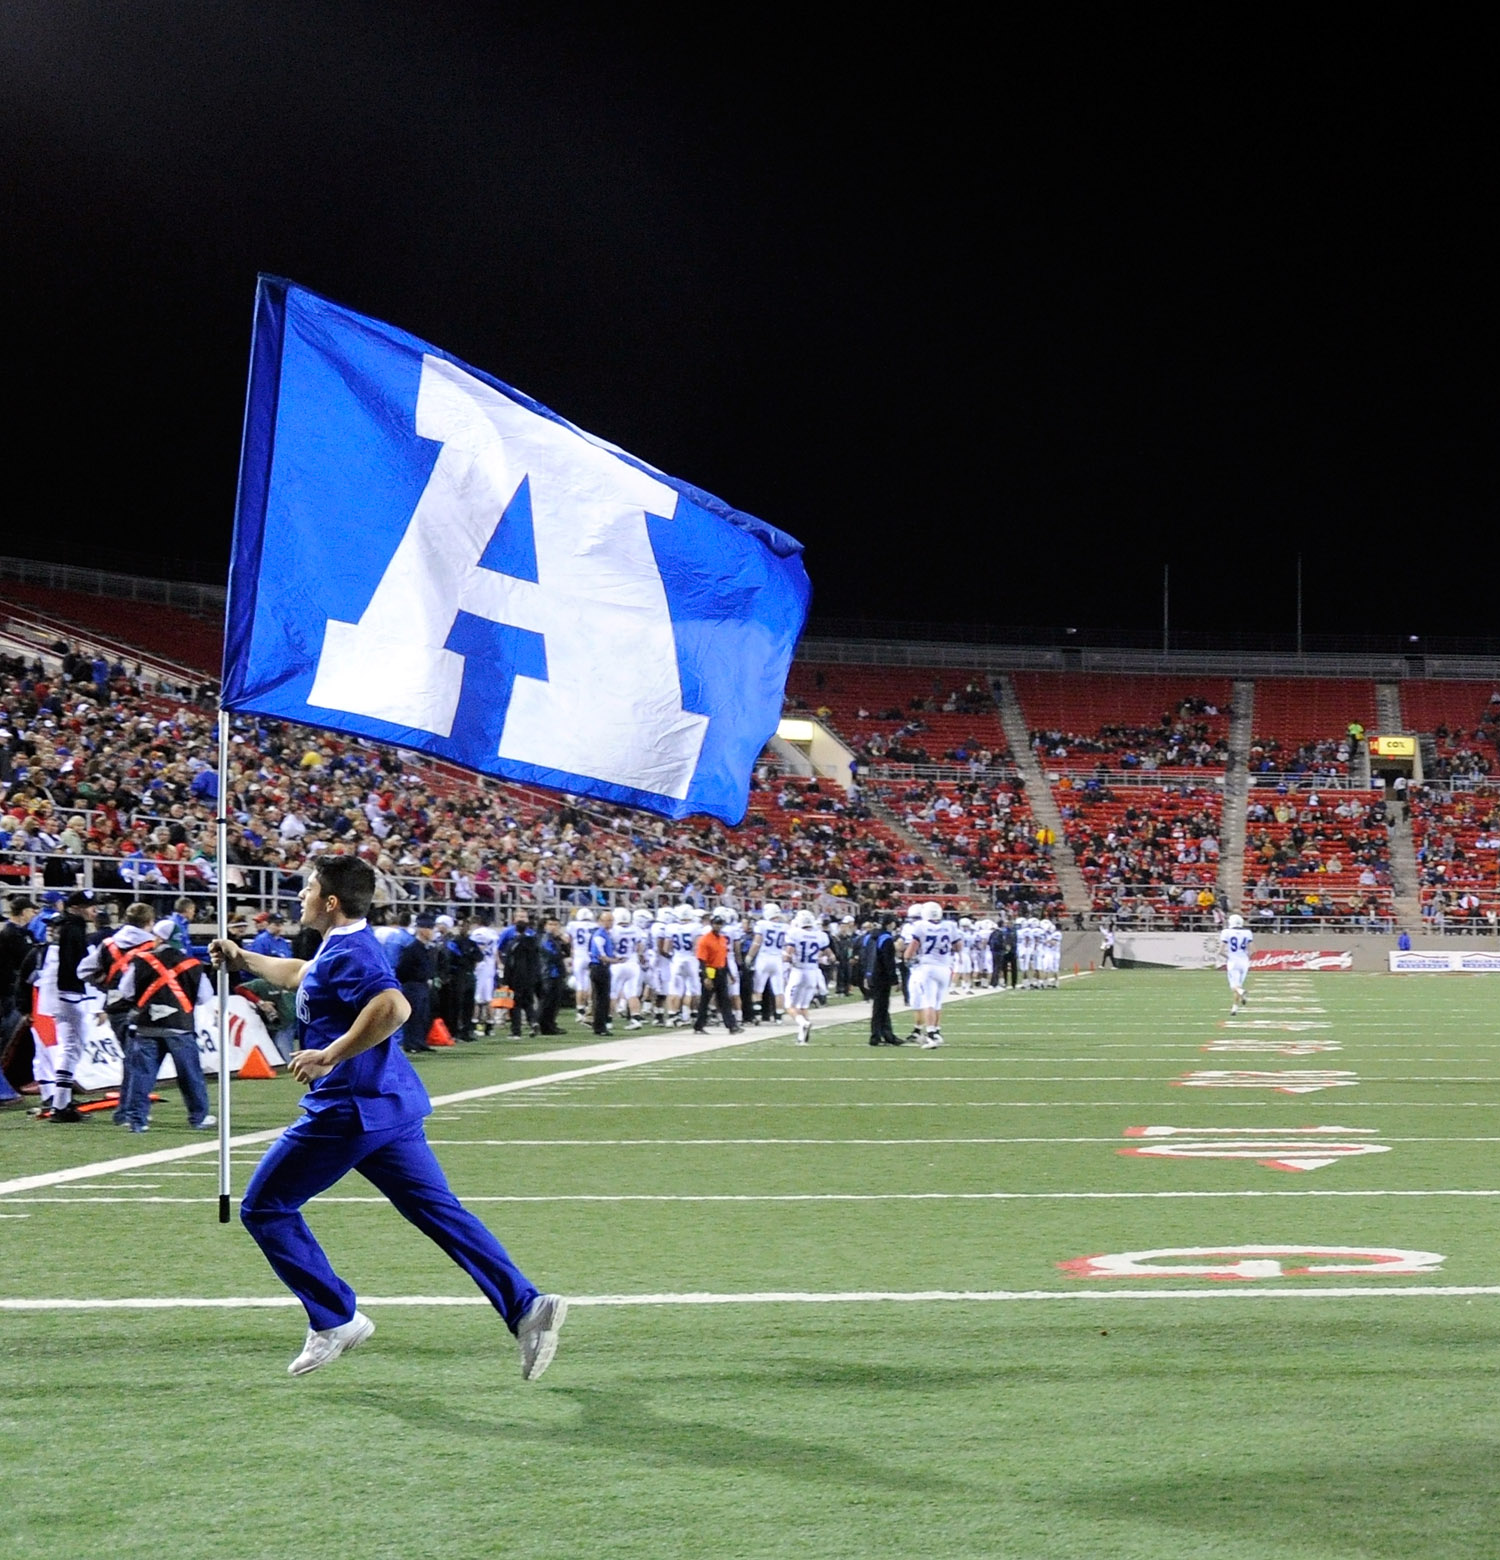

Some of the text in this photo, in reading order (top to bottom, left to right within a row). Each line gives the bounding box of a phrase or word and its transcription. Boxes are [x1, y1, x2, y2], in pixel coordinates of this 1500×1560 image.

[306, 353, 709, 800] A
[764, 929, 786, 949] 50
[925, 935, 950, 954] 73
[1230, 936, 1247, 952] 94
[799, 941, 820, 963] 12
[1248, 950, 1320, 967] udweiser
